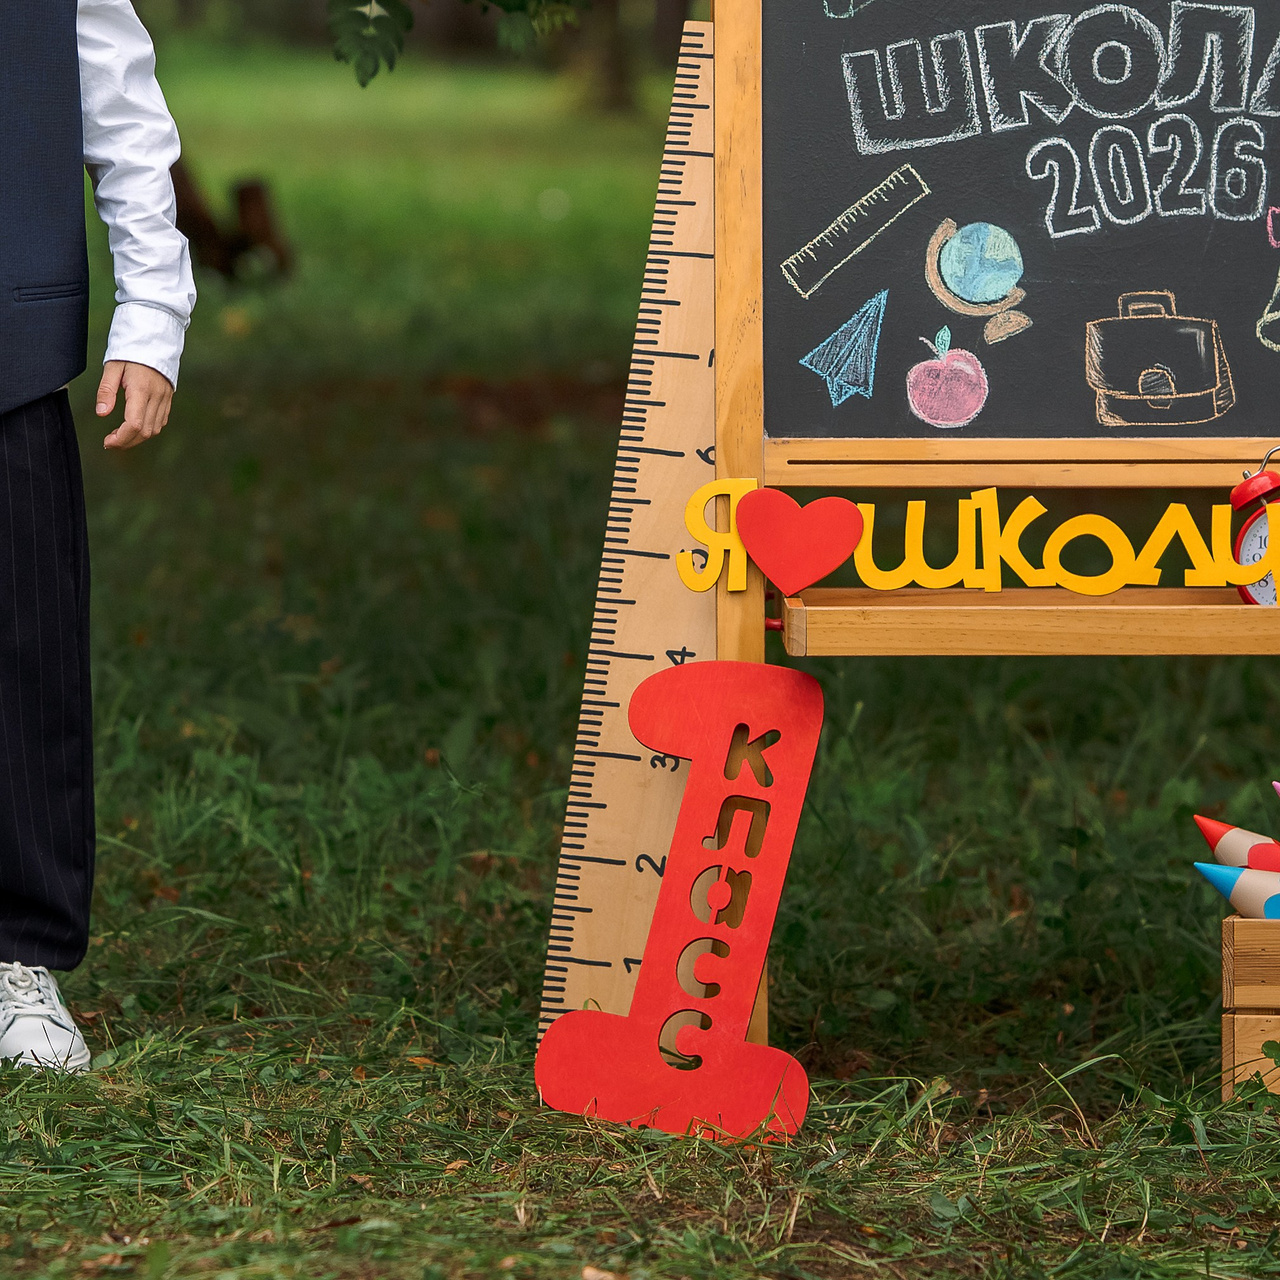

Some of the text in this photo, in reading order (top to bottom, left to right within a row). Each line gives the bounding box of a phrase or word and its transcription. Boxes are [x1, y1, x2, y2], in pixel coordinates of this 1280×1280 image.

[841, 0, 1280, 156] ШКОЛ
[1025, 113, 1267, 239] 2026
[676, 478, 758, 592] Я
[666, 646, 696, 666] 4
[650, 754, 680, 772] 3
[534, 661, 824, 1147] 1
[635, 853, 667, 878] 2
